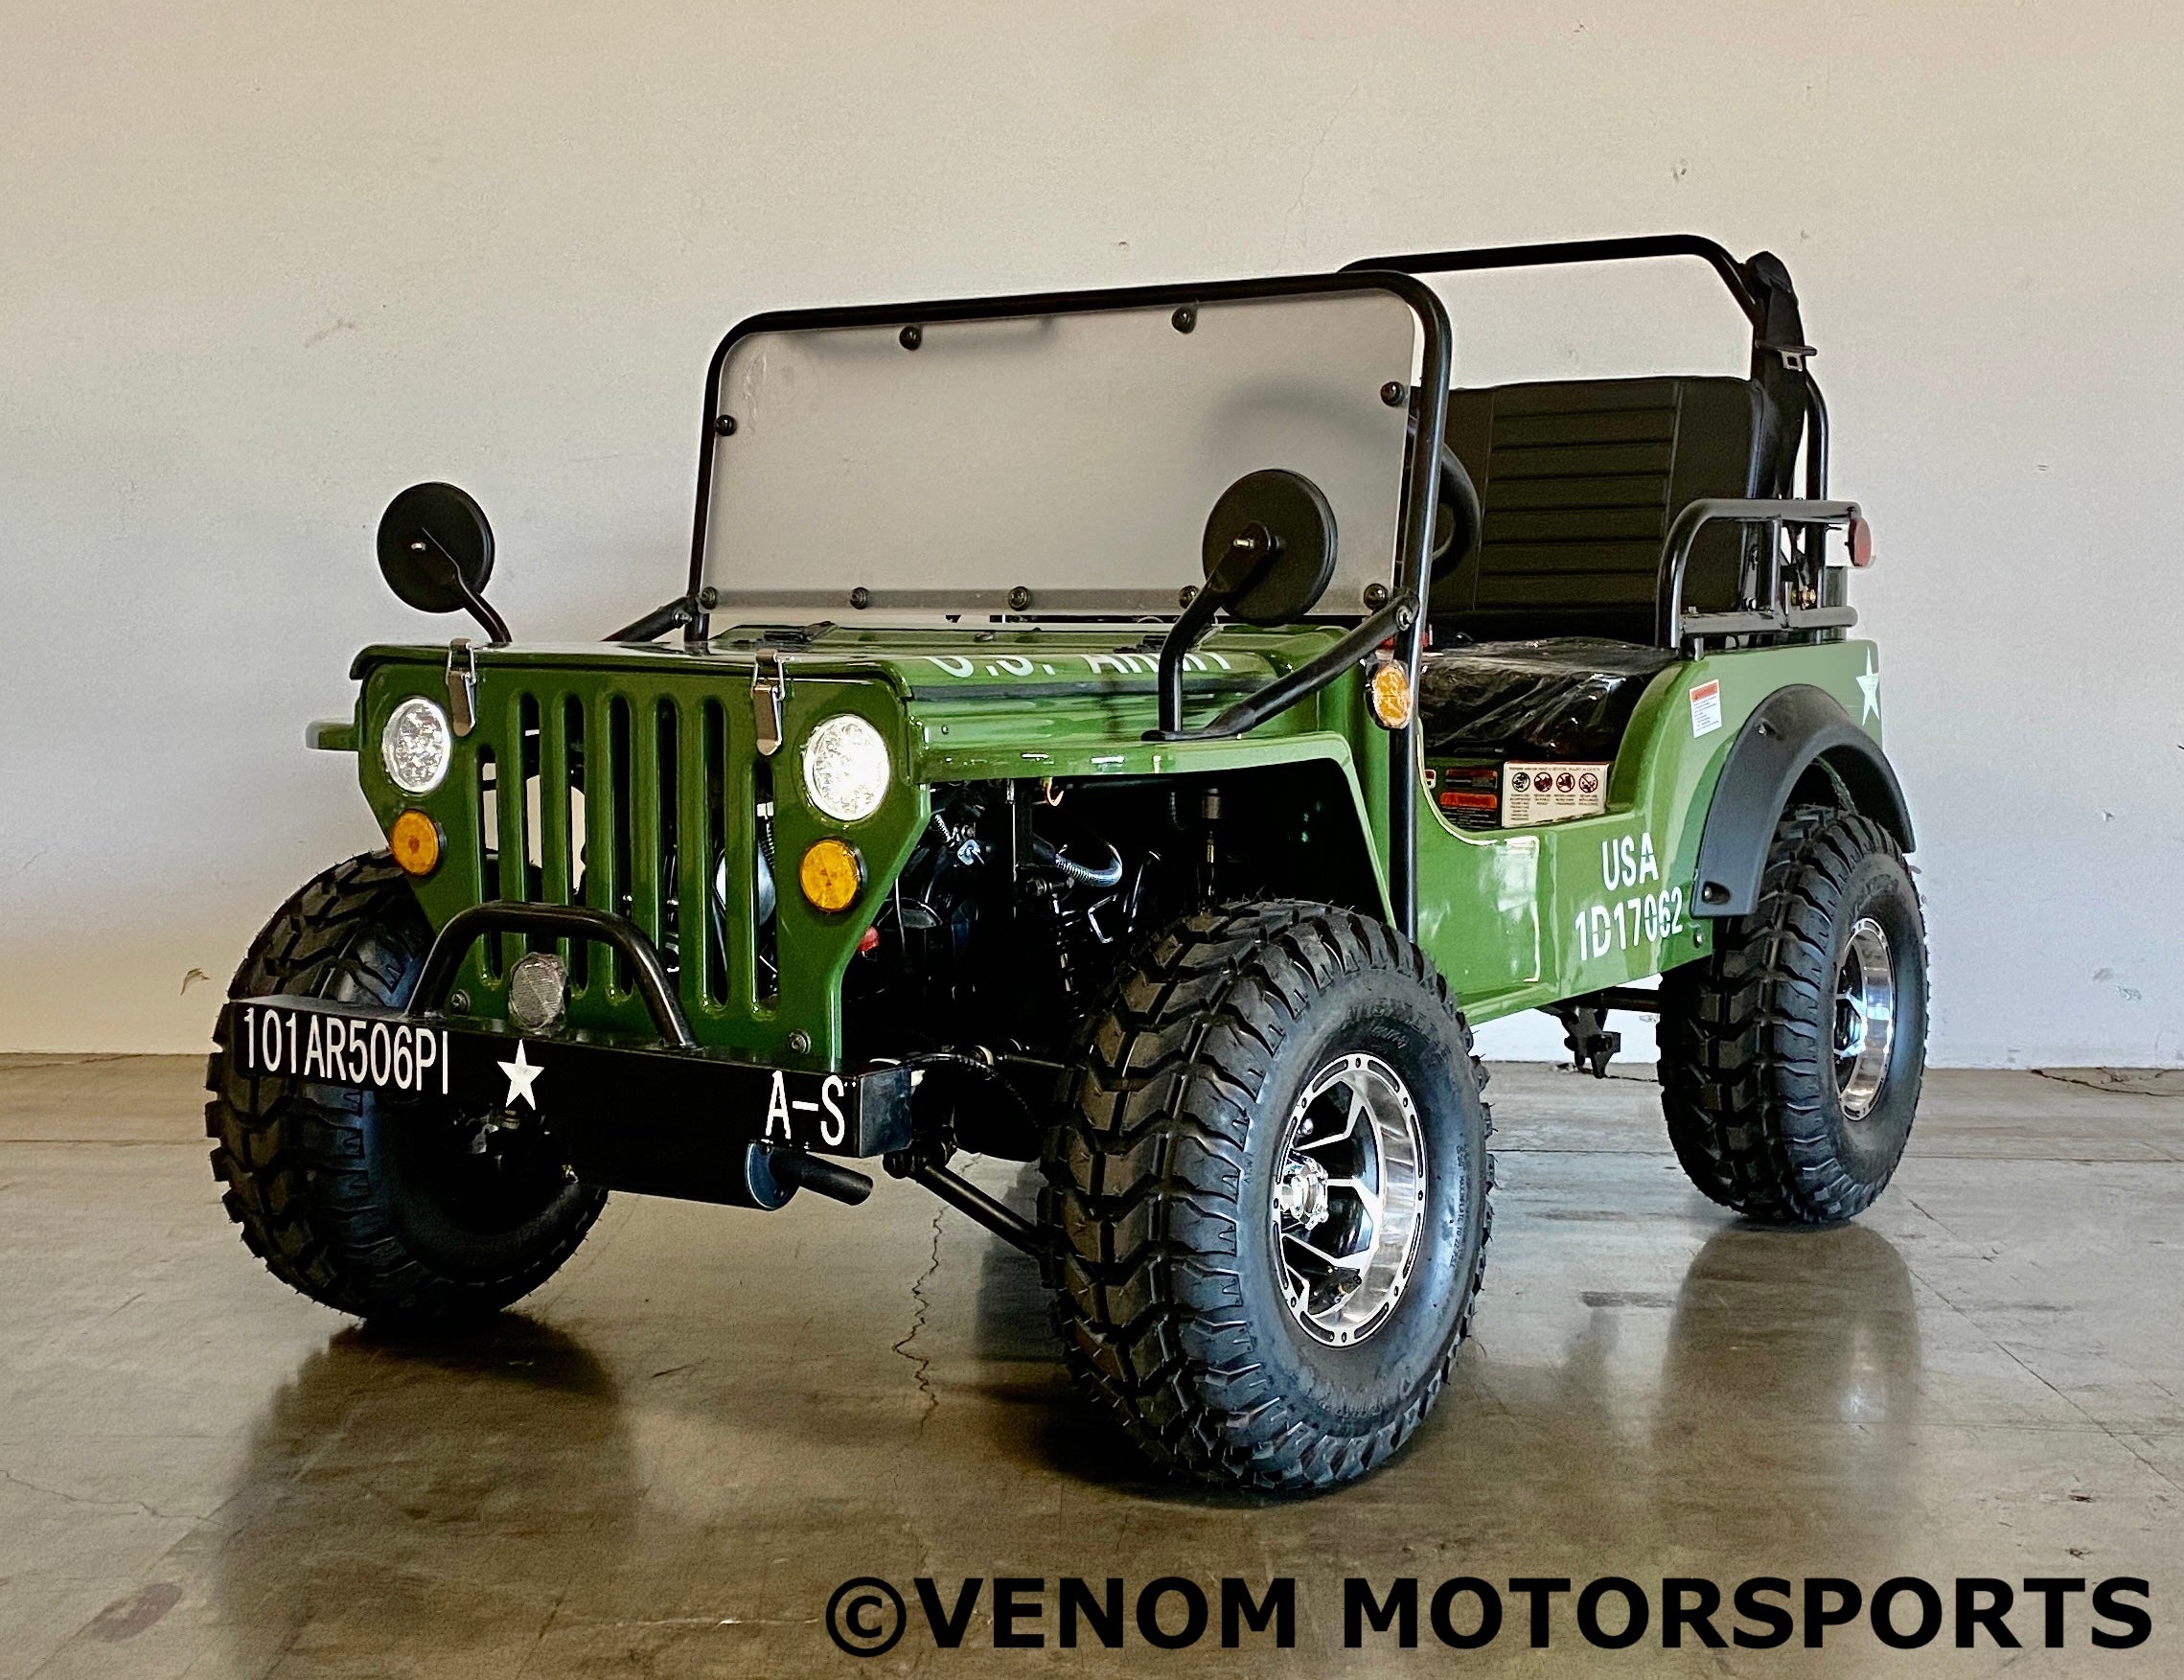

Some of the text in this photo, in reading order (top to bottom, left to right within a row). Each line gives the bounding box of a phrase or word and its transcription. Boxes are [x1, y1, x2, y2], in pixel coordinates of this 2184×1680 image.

[1601, 832, 1660, 891] USA
[1575, 886, 1684, 961] 1D17062
[765, 1070, 845, 1146] A-S
